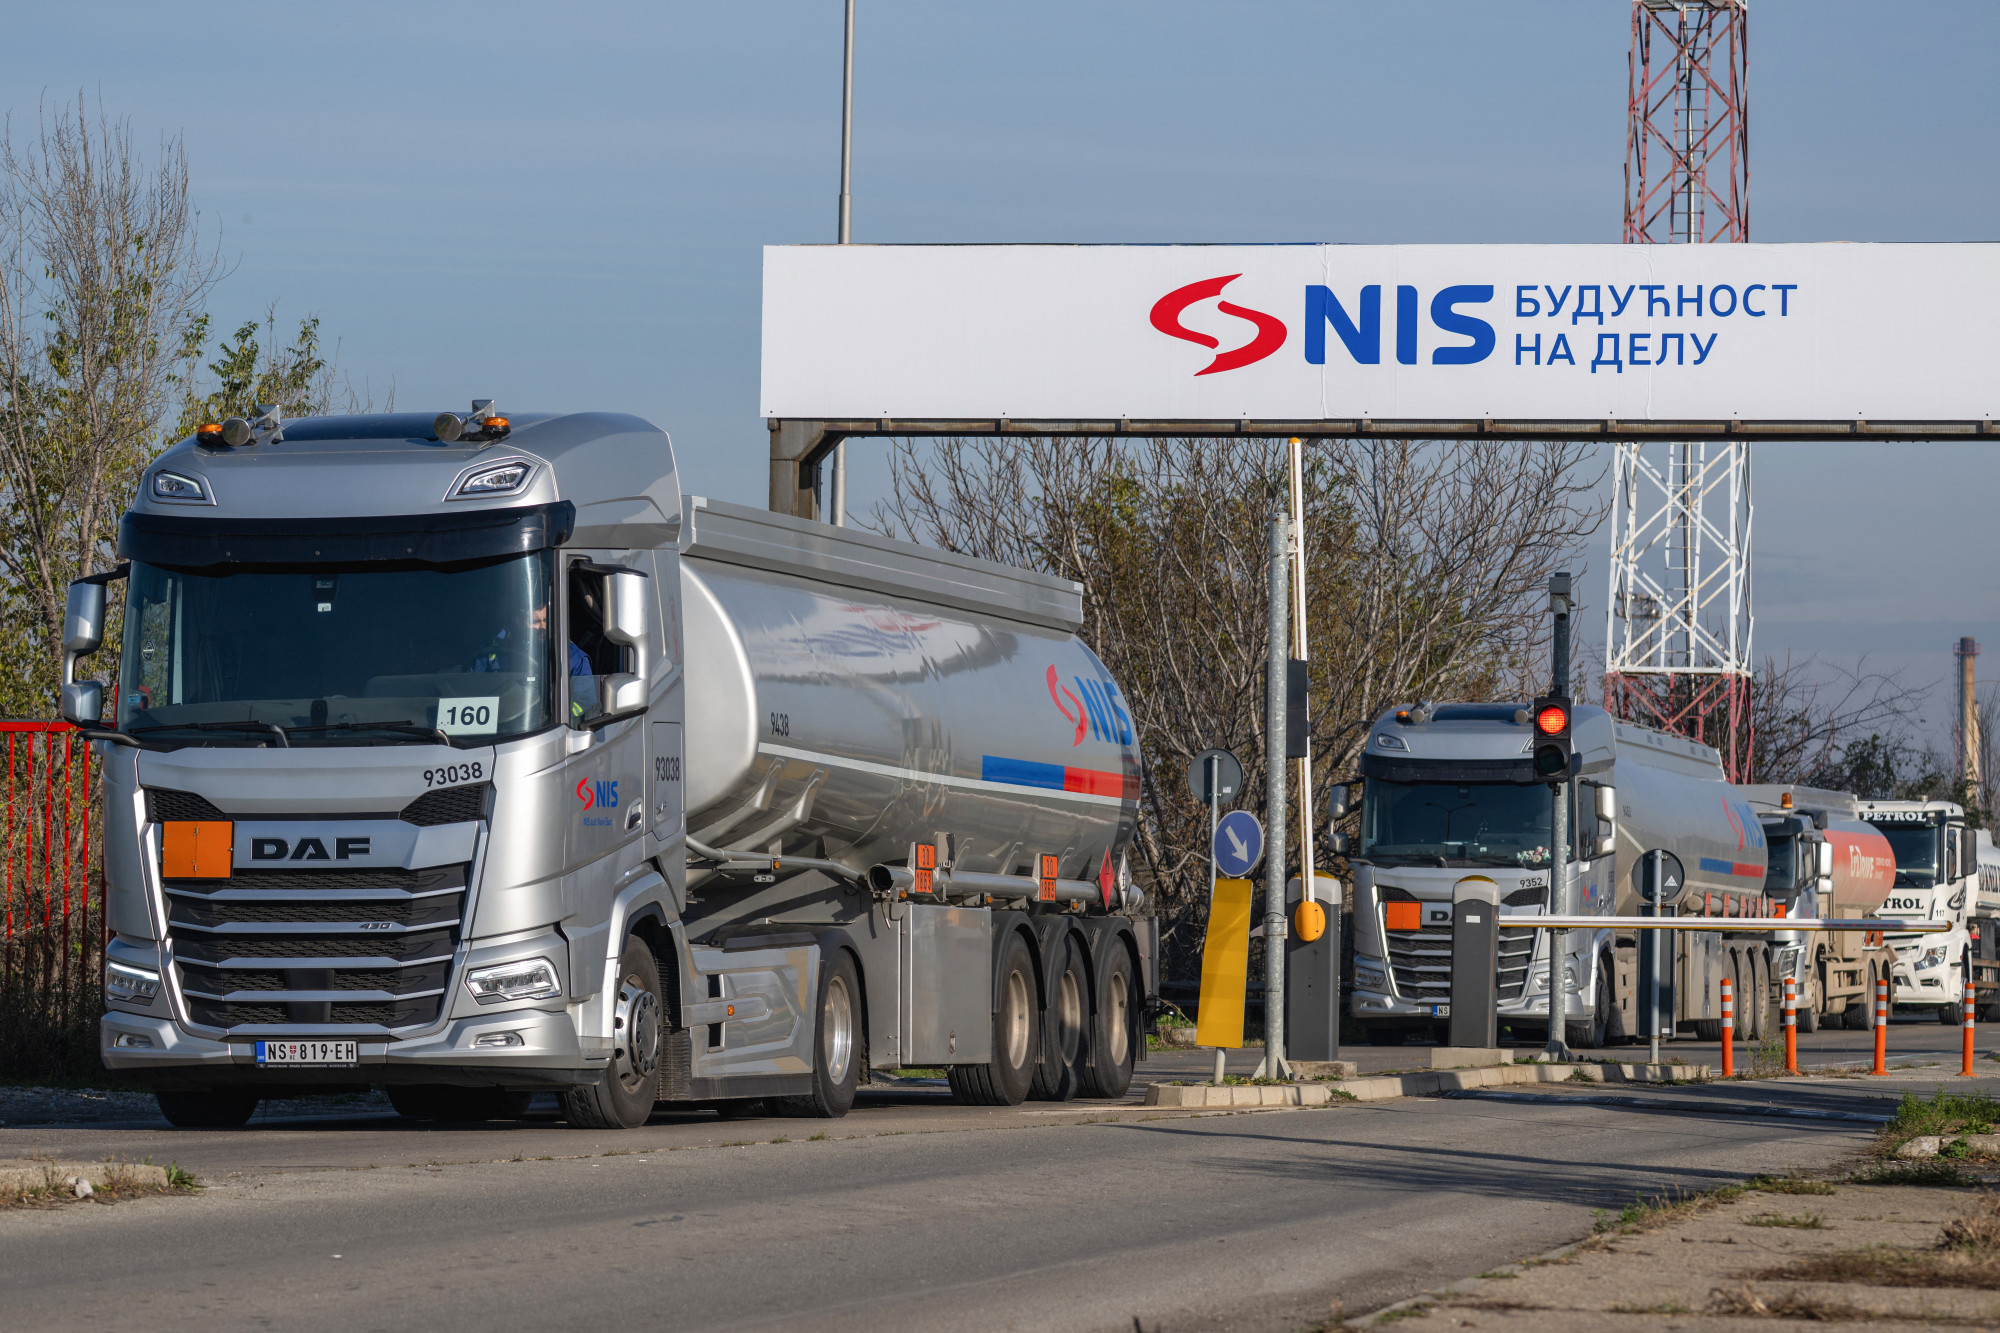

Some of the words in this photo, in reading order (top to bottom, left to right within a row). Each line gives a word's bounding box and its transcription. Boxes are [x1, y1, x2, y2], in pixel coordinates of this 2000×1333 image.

[1515, 284, 1798, 326] БУДУЋНОСТ
[1304, 284, 1496, 365] NIS
[1515, 333, 1576, 366] НА
[1591, 333, 1718, 374] ДЕЛУ
[446, 705, 490, 726] 160
[1073, 675, 1132, 746] NIS
[770, 711, 790, 737] 9438
[423, 761, 483, 788] 93038
[655, 756, 680, 782] 93038
[596, 780, 618, 808] NIS
[1733, 801, 1763, 849] NIS
[1862, 811, 1927, 822] PETROL
[250, 836, 372, 861] DAF
[1519, 877, 1543, 888] 9352
[1882, 898, 1925, 910] TROL
[359, 922, 392, 930] 430
[268, 1043, 287, 1060] NS
